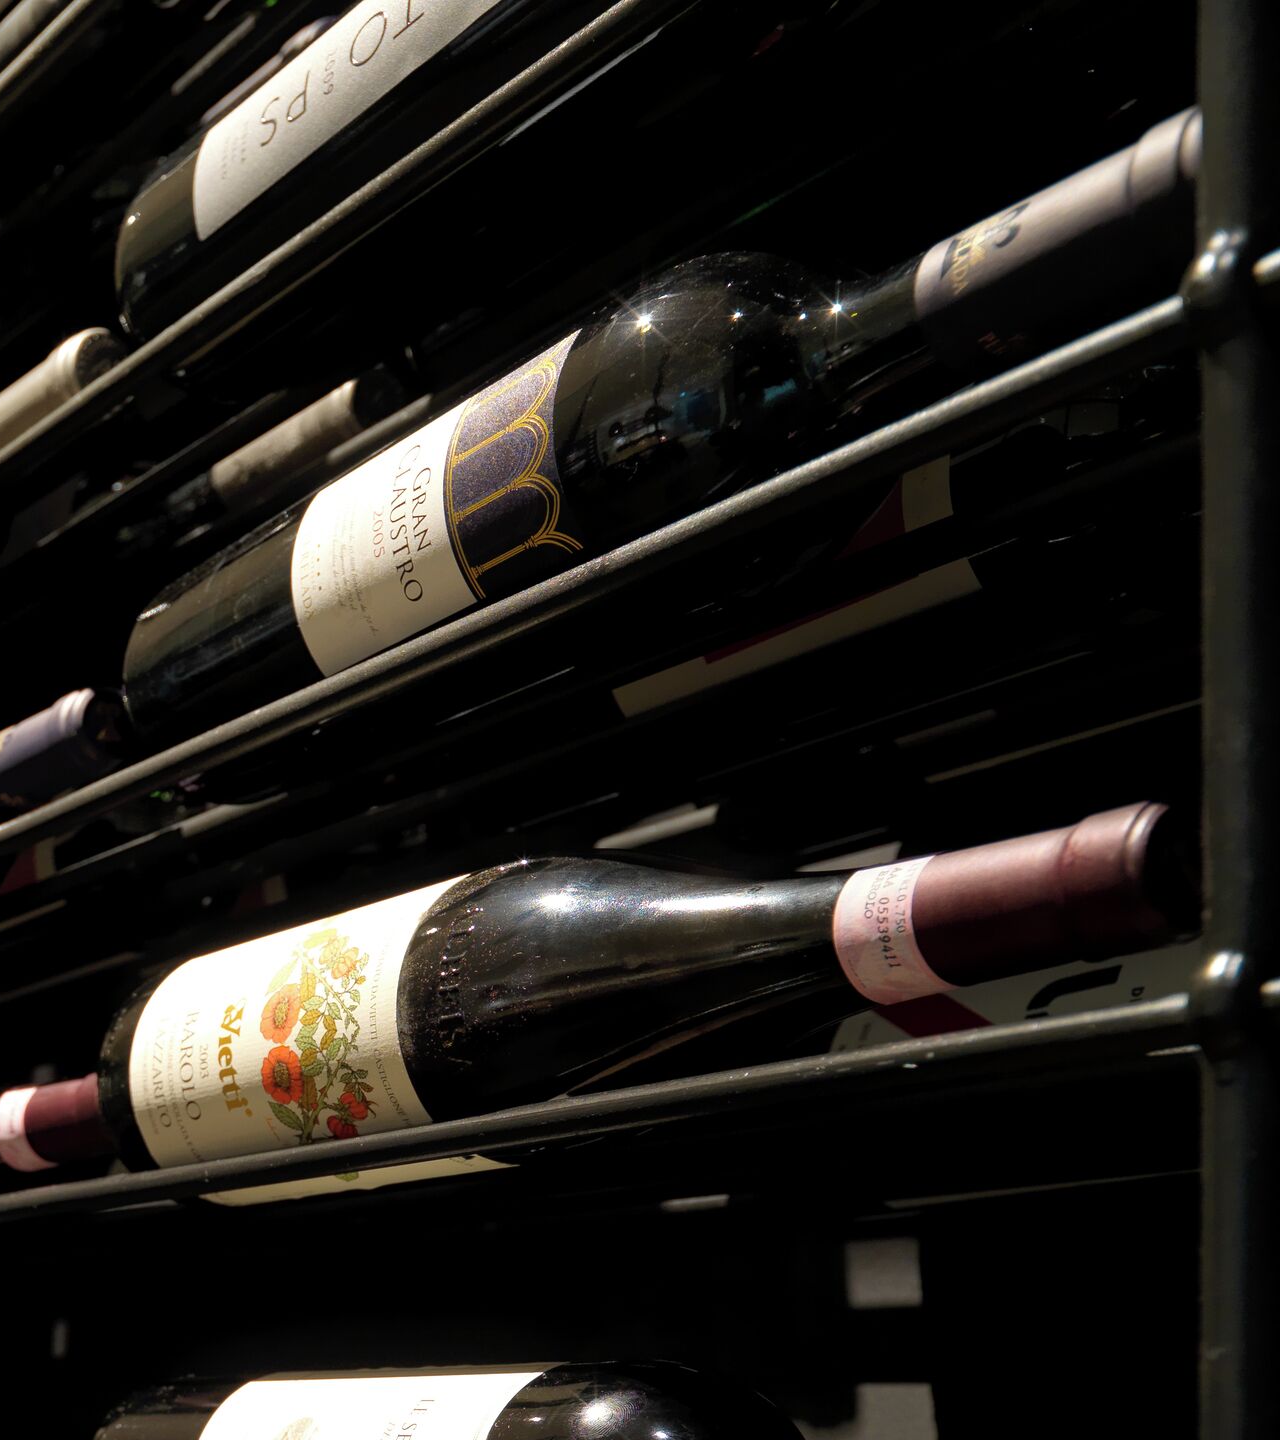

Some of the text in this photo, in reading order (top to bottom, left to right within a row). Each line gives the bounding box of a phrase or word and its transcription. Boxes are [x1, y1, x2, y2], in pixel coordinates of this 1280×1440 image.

[260, 69, 310, 147] PS
[372, 509, 385, 559] 2005
[390, 445, 423, 602] CLAUSTRO
[412, 467, 432, 553] GRAN
[863, 871, 887, 920] BAROLO
[876, 897, 902, 969] 05539411
[179, 1009, 202, 1121] BAROLO
[198, 1044, 210, 1080] 2003
[218, 1003, 248, 1114] Vietti
